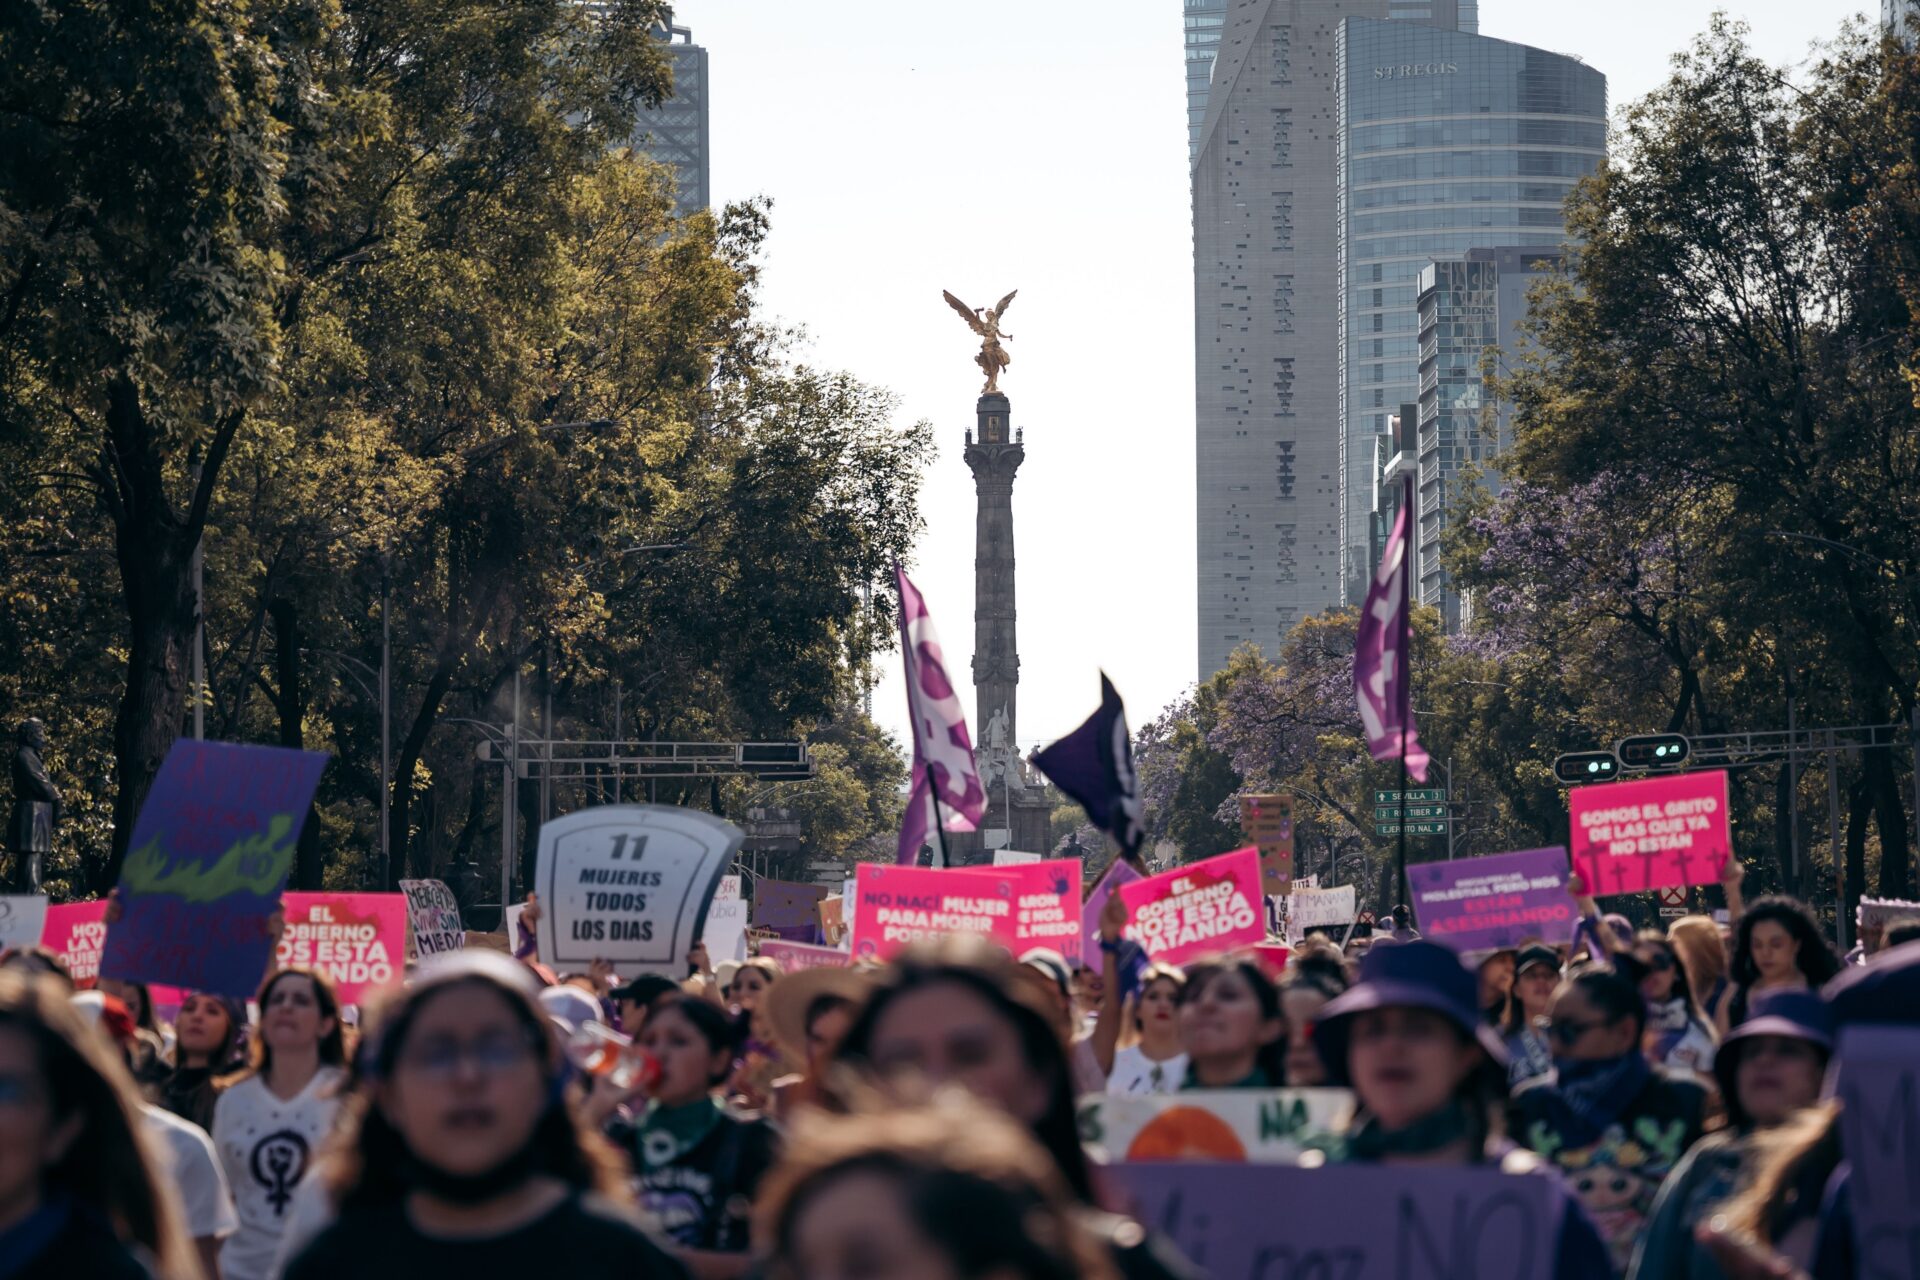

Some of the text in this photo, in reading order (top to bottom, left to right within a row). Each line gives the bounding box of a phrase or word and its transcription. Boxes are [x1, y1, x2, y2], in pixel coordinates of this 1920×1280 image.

[1400, 62, 1458, 78] REGIS
[1410, 808, 1431, 817] TIBER
[1580, 797, 1717, 827] SOMOS EL GRITO
[1382, 825, 1415, 833] EJERITO
[1589, 814, 1711, 842] DE LAS QUE YA
[610, 834, 648, 860] 11
[1610, 838, 1636, 856] NO
[579, 869, 662, 887] MUJERES
[1171, 877, 1196, 895] EL
[1531, 876, 1561, 890] NOS
[586, 892, 647, 912] TODOS
[864, 892, 891, 906] NO
[942, 895, 1010, 917] MUJER
[1136, 881, 1235, 921] GOBIERNO
[310, 905, 334, 922] EL
[877, 908, 993, 932] PARA MORIR
[1032, 909, 1064, 923] NOS
[1124, 912, 1179, 942] NOS
[1182, 892, 1250, 926] ESTA
[1430, 903, 1570, 936] ASESINANDO
[572, 920, 653, 940] LOS DIAS
[884, 924, 925, 942] POR
[1031, 921, 1080, 938] MIEDO
[317, 941, 389, 962] ESTA
[417, 932, 464, 955] MIEDO
